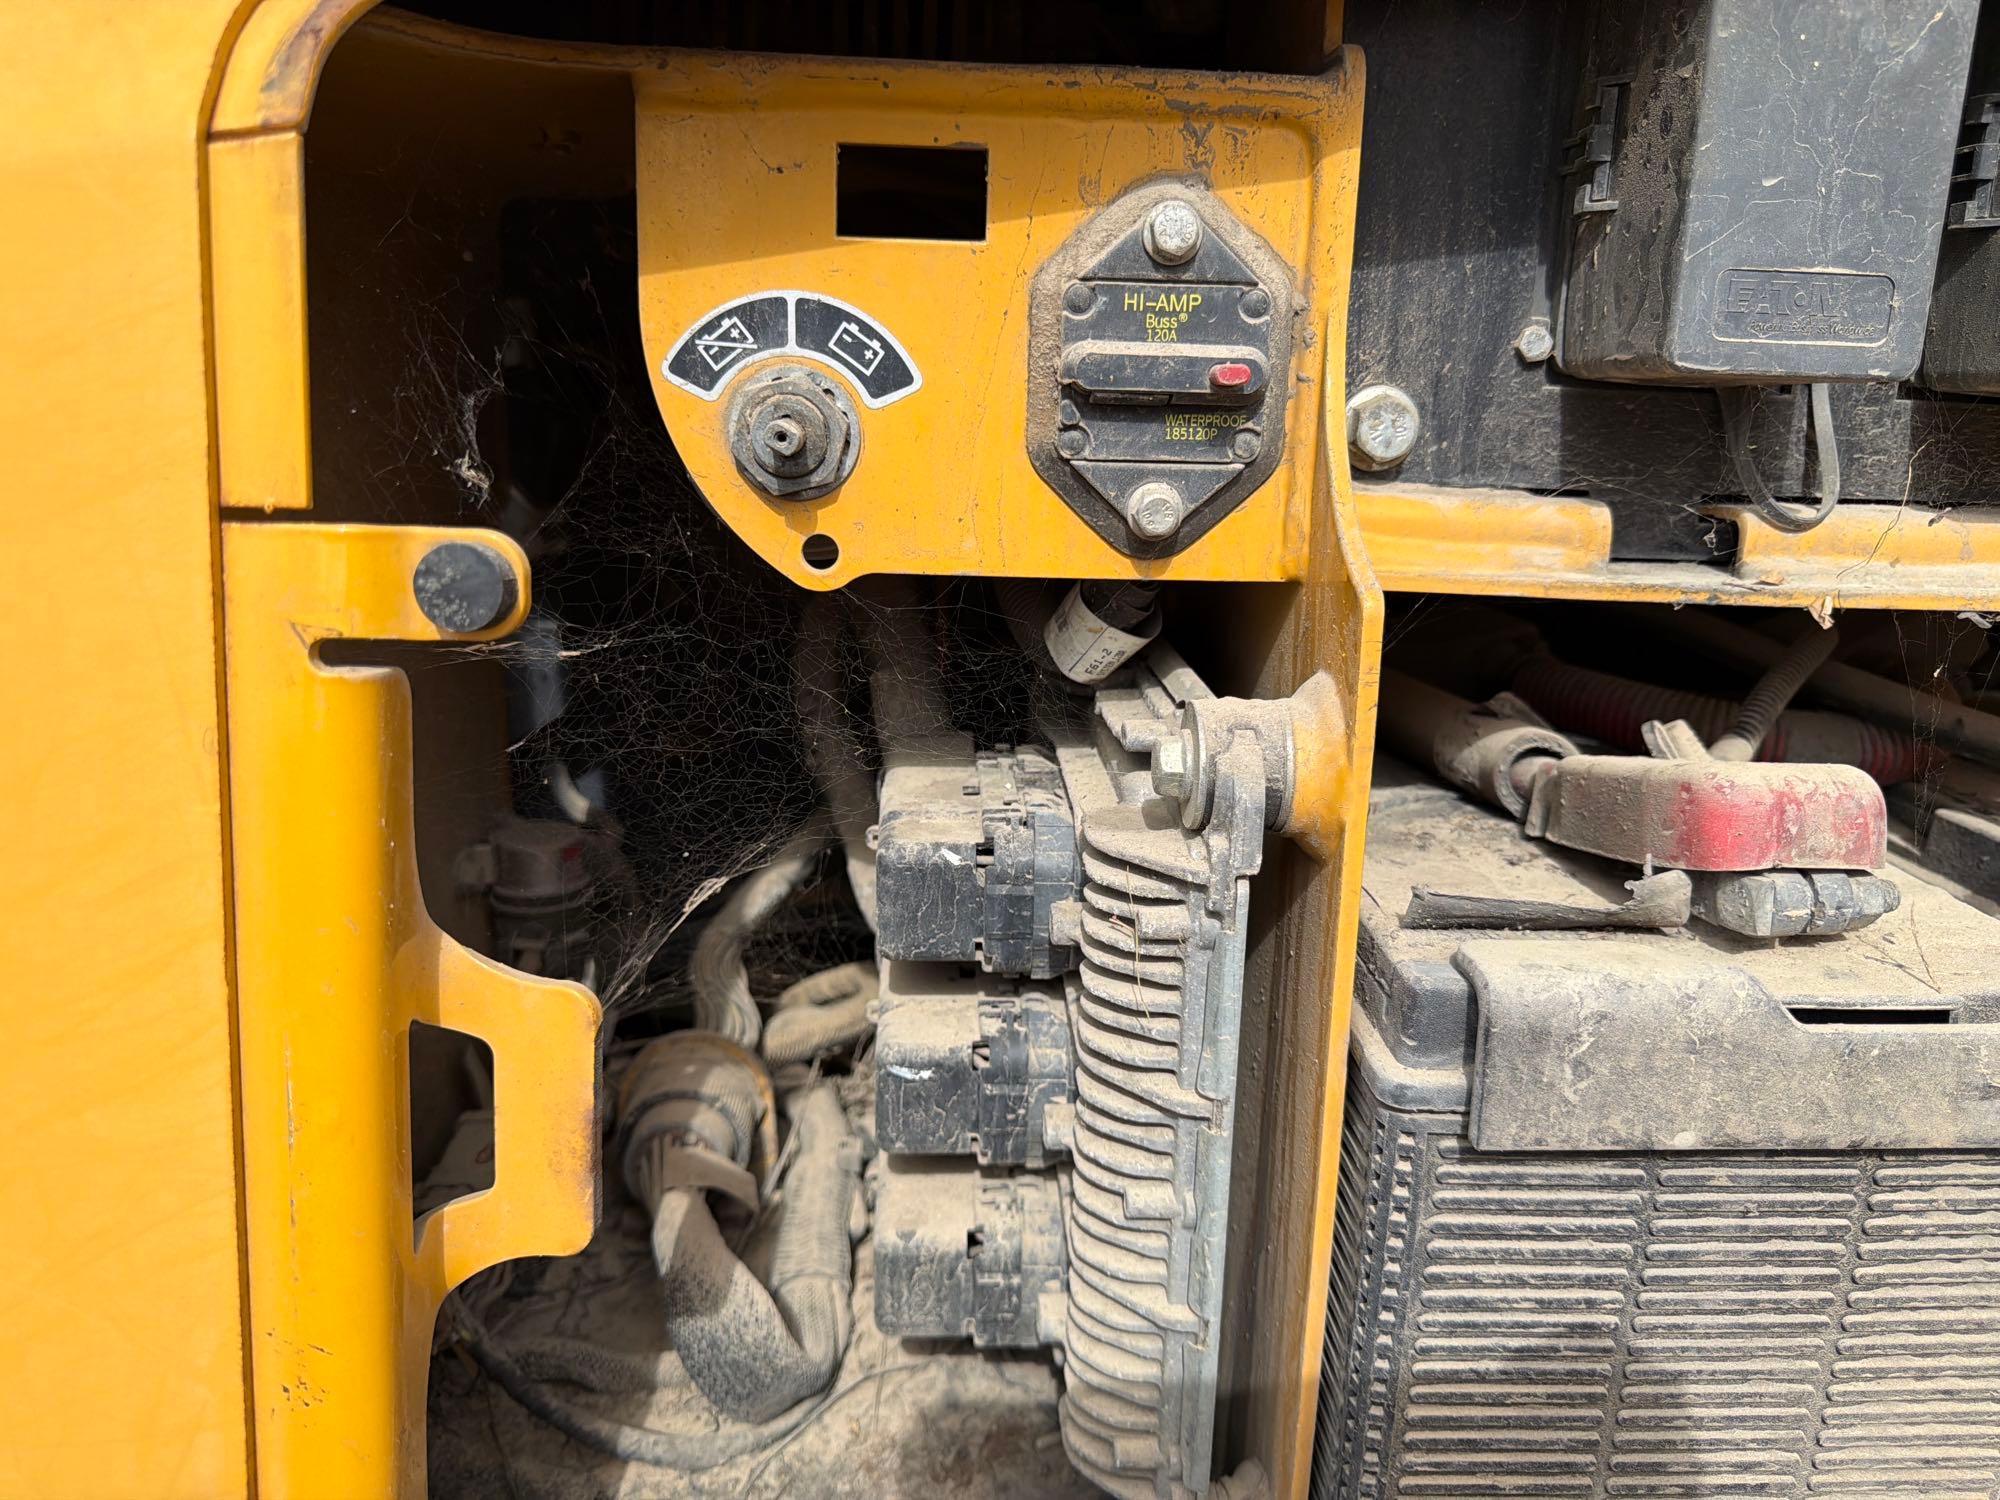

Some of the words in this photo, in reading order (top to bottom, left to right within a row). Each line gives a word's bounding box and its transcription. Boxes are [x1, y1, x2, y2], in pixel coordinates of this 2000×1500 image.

[1123, 292, 1202, 312] HI-AMP
[1146, 329, 1178, 342] 120A
[1165, 413, 1248, 427] WATERPROOF
[1165, 427, 1218, 441] 185120P
